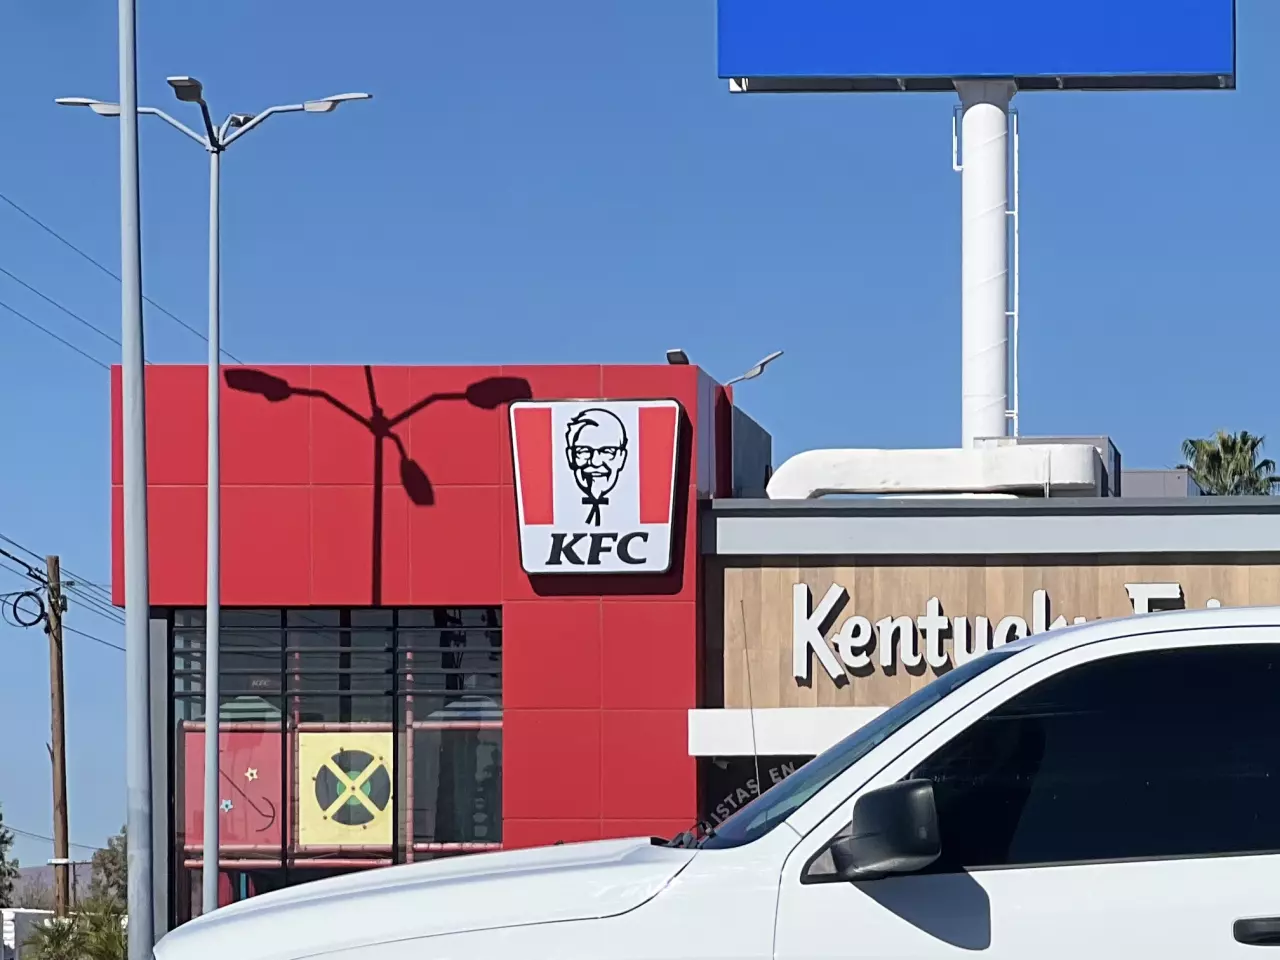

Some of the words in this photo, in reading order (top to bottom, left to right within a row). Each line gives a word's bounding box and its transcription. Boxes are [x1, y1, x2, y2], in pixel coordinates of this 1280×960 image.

[545, 532, 649, 565] KFC
[792, 583, 1090, 680] Kentuck
[704, 779, 759, 831] ISTAS
